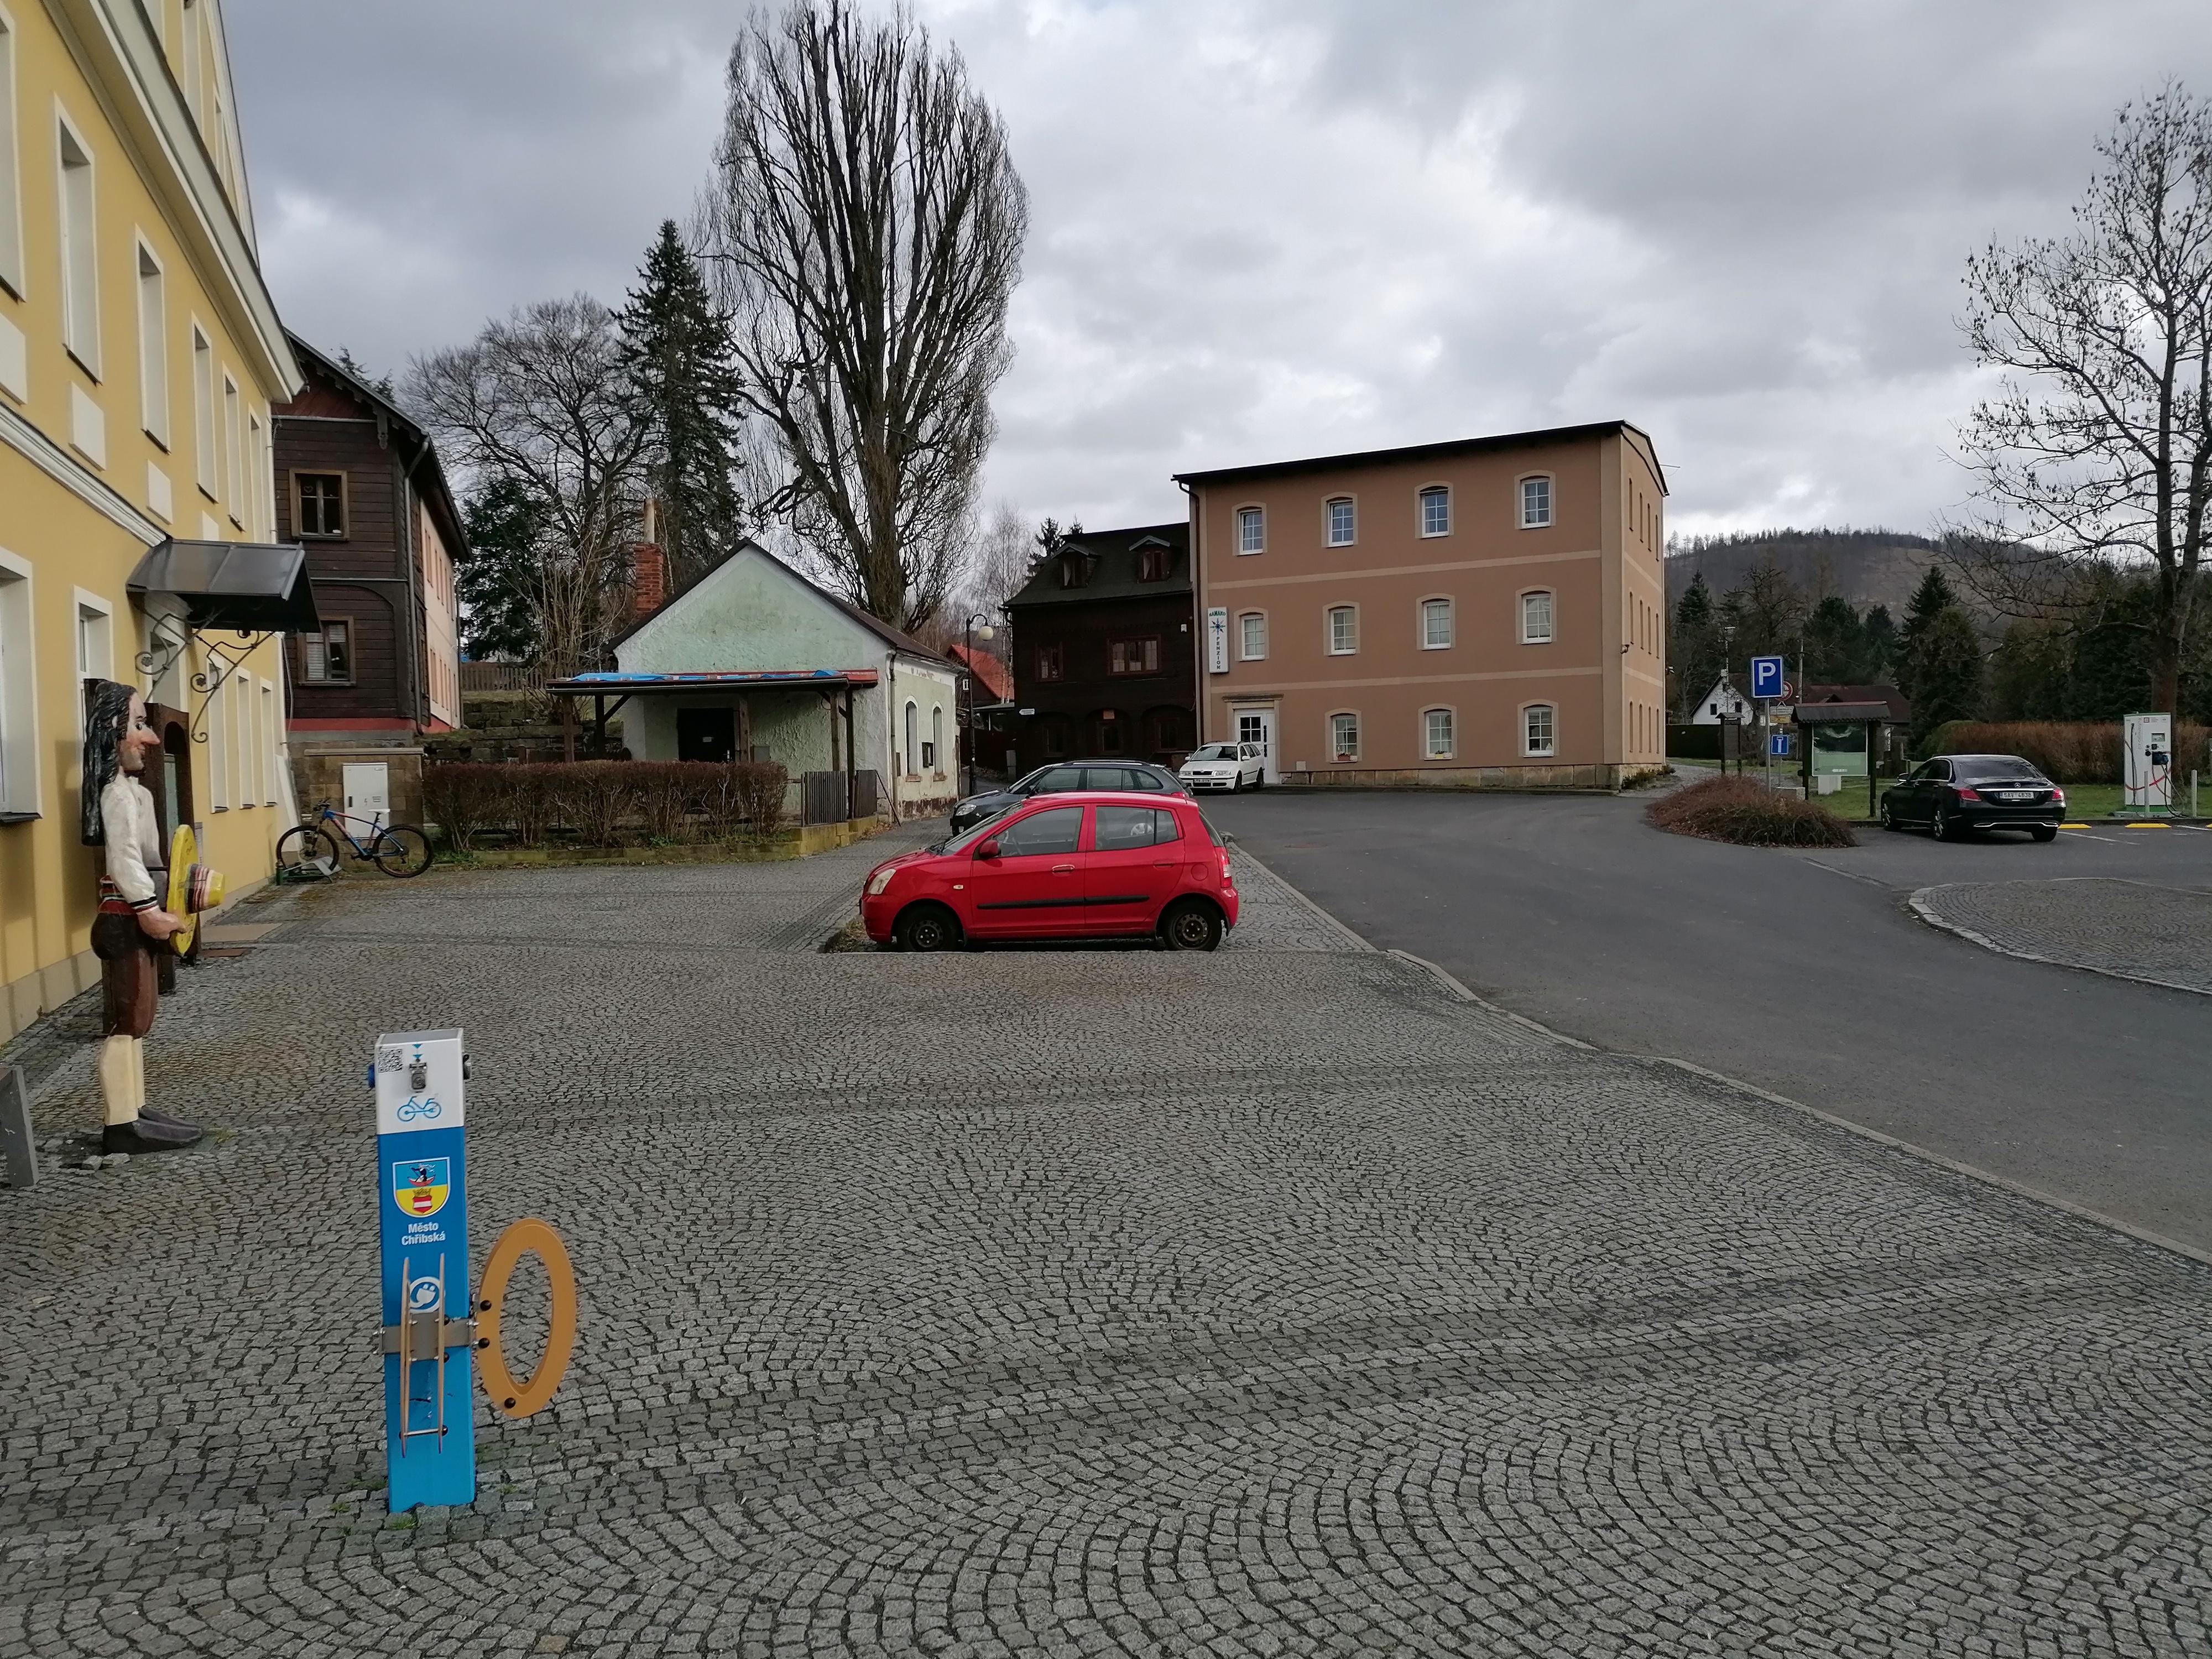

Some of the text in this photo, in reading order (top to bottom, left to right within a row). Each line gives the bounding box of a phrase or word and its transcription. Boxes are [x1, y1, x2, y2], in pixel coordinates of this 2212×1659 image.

[1759, 662, 1776, 685] P
[408, 1222, 439, 1234] Město
[401, 1231, 446, 1245] Chřibská
